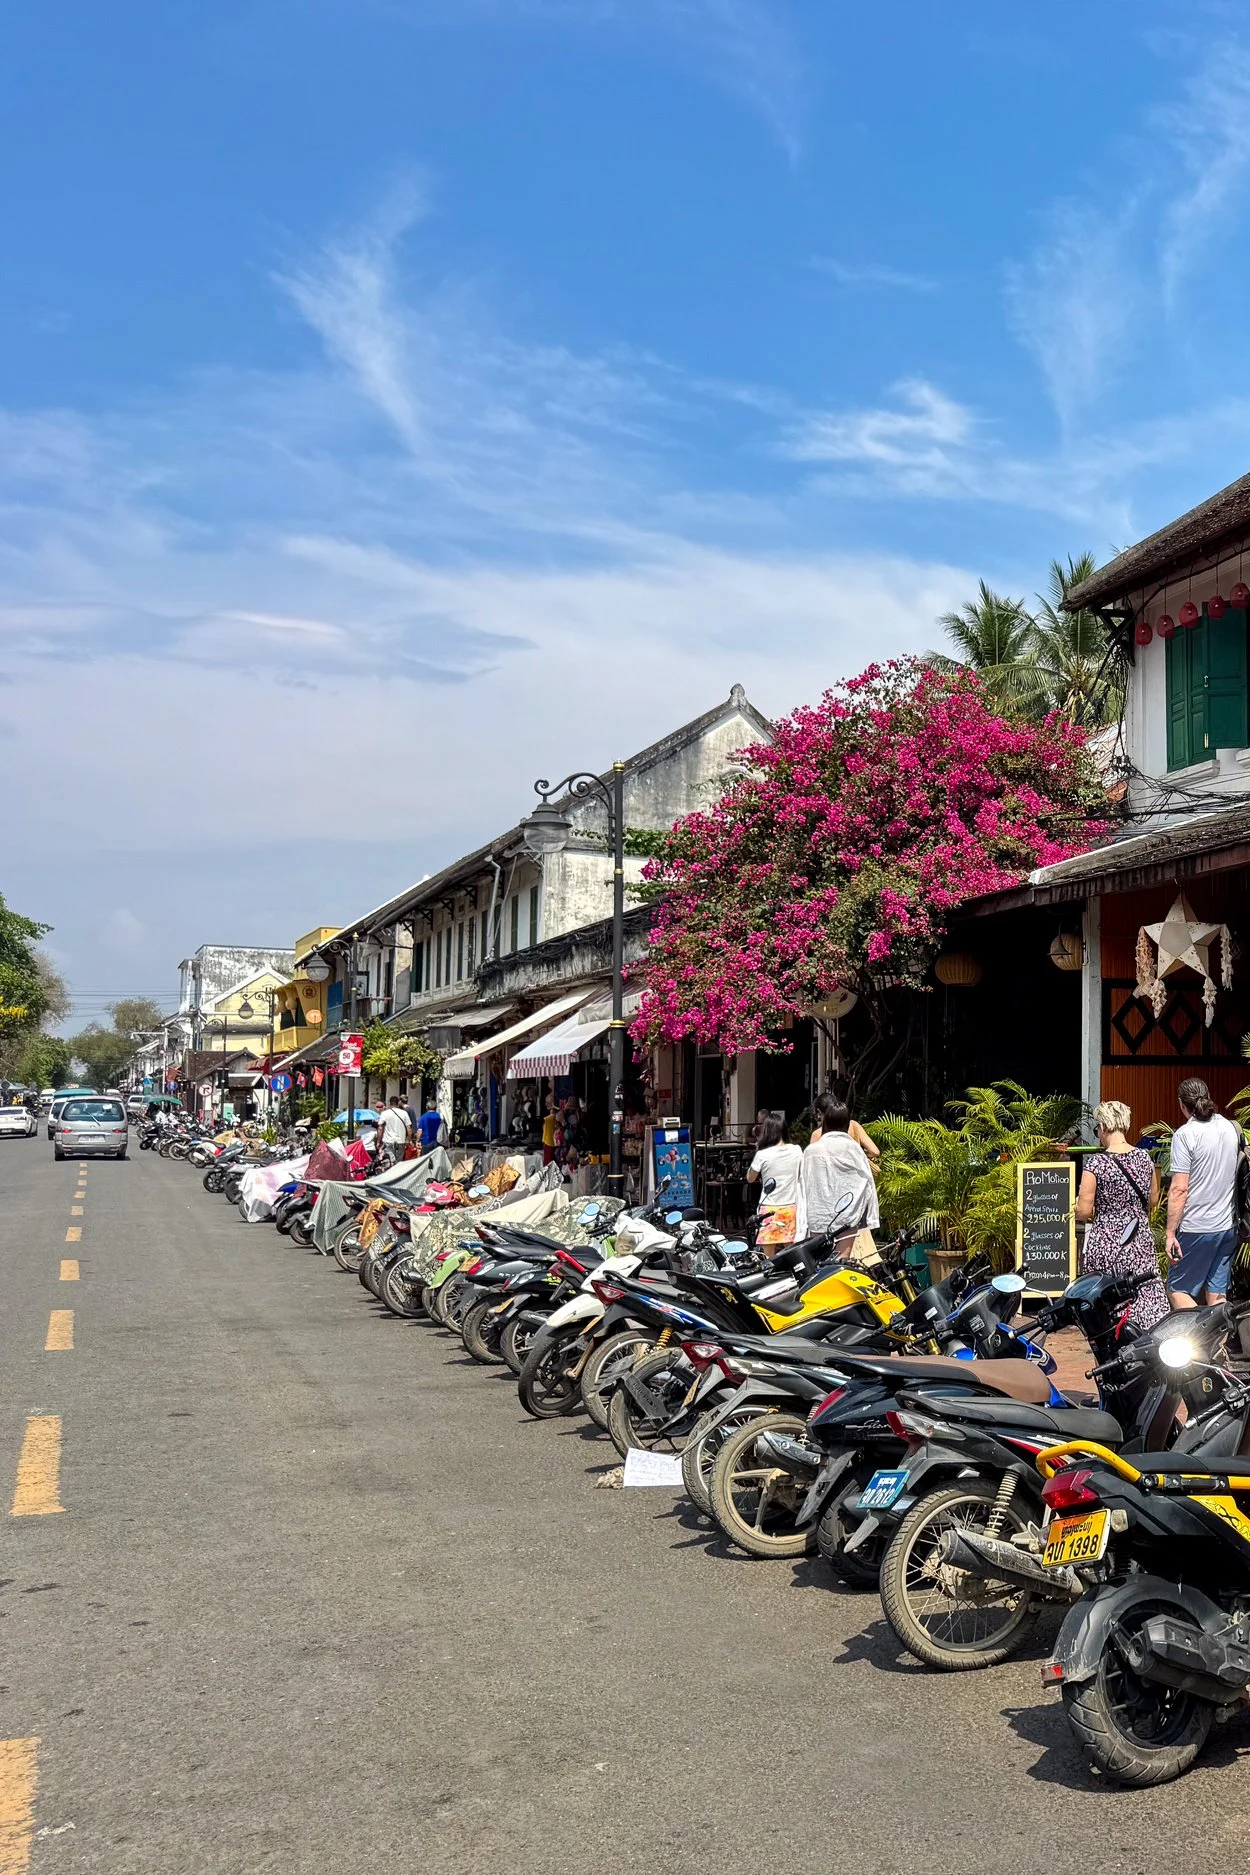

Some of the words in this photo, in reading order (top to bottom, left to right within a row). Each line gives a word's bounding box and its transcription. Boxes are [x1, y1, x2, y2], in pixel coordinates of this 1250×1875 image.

[1025, 1189, 1033, 1201] 2
[1023, 1227, 1031, 1239] 2
[1054, 1231, 1065, 1240] of
[1068, 1533, 1099, 1558] 1398
